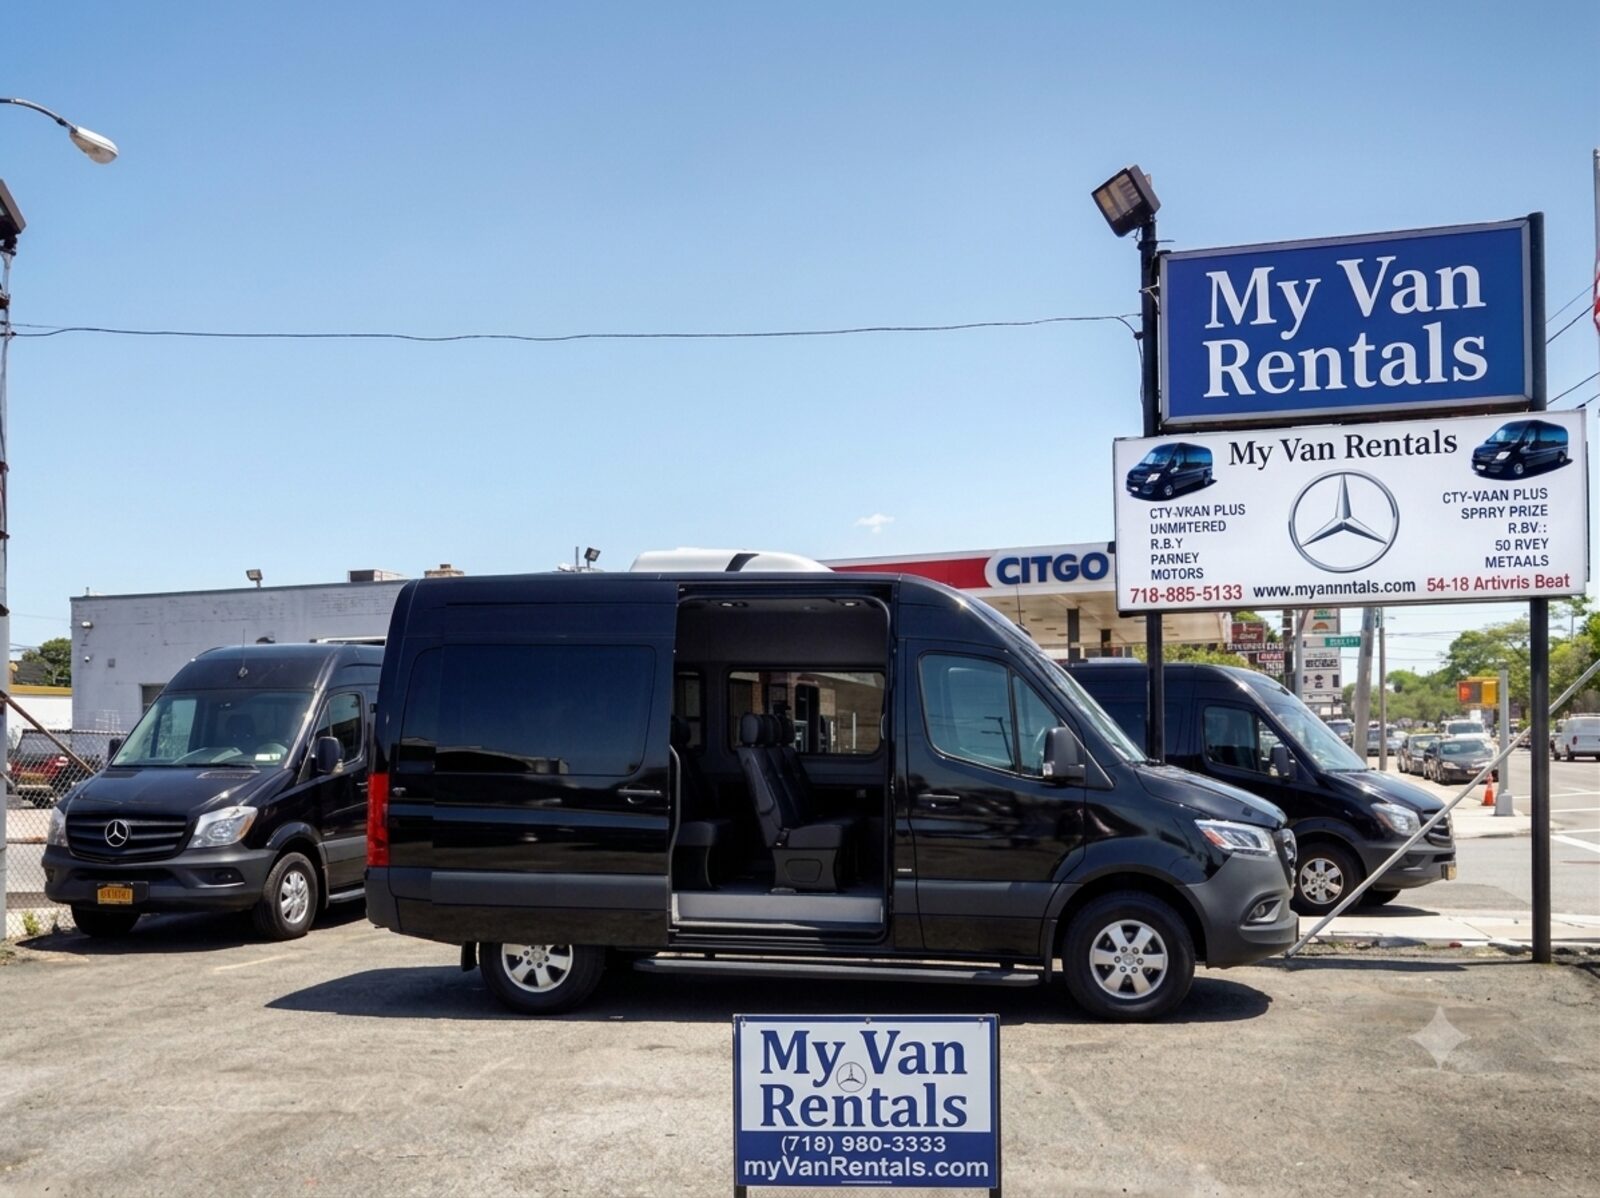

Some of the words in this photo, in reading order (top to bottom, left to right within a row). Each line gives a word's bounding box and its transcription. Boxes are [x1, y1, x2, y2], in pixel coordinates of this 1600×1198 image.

[1205, 266, 1321, 340] My
[1337, 256, 1487, 317] Van
[1203, 322, 1488, 398] Rentals
[1228, 440, 1273, 470] My
[1279, 437, 1336, 462] Van
[1344, 429, 1458, 459] Rentals
[1442, 489, 1509, 504] CTY-VAAN
[1513, 487, 1548, 501] PLUS
[1214, 503, 1246, 516] PLUS
[1509, 504, 1548, 518] PRIZE
[1150, 538, 1183, 550] R.B.Y
[1495, 539, 1511, 551] 50
[1515, 538, 1549, 550] RVEY
[1151, 552, 1200, 565] PARNEY
[1485, 554, 1549, 569] METAALS
[996, 551, 1109, 585] CITGO
[1151, 567, 1204, 580] MOTORS
[1427, 577, 1469, 592] 54-18
[1473, 575, 1530, 591] Artivris
[1535, 573, 1570, 589] Beat
[1130, 584, 1243, 604] 718-885-5133
[760, 1030, 846, 1088] My
[859, 1030, 967, 1075] Van
[760, 1082, 967, 1128] Rentals
[781, 1136, 834, 1154] (718)
[841, 1136, 946, 1152] 980-3333
[744, 1155, 989, 1180] myVanRentals.com
